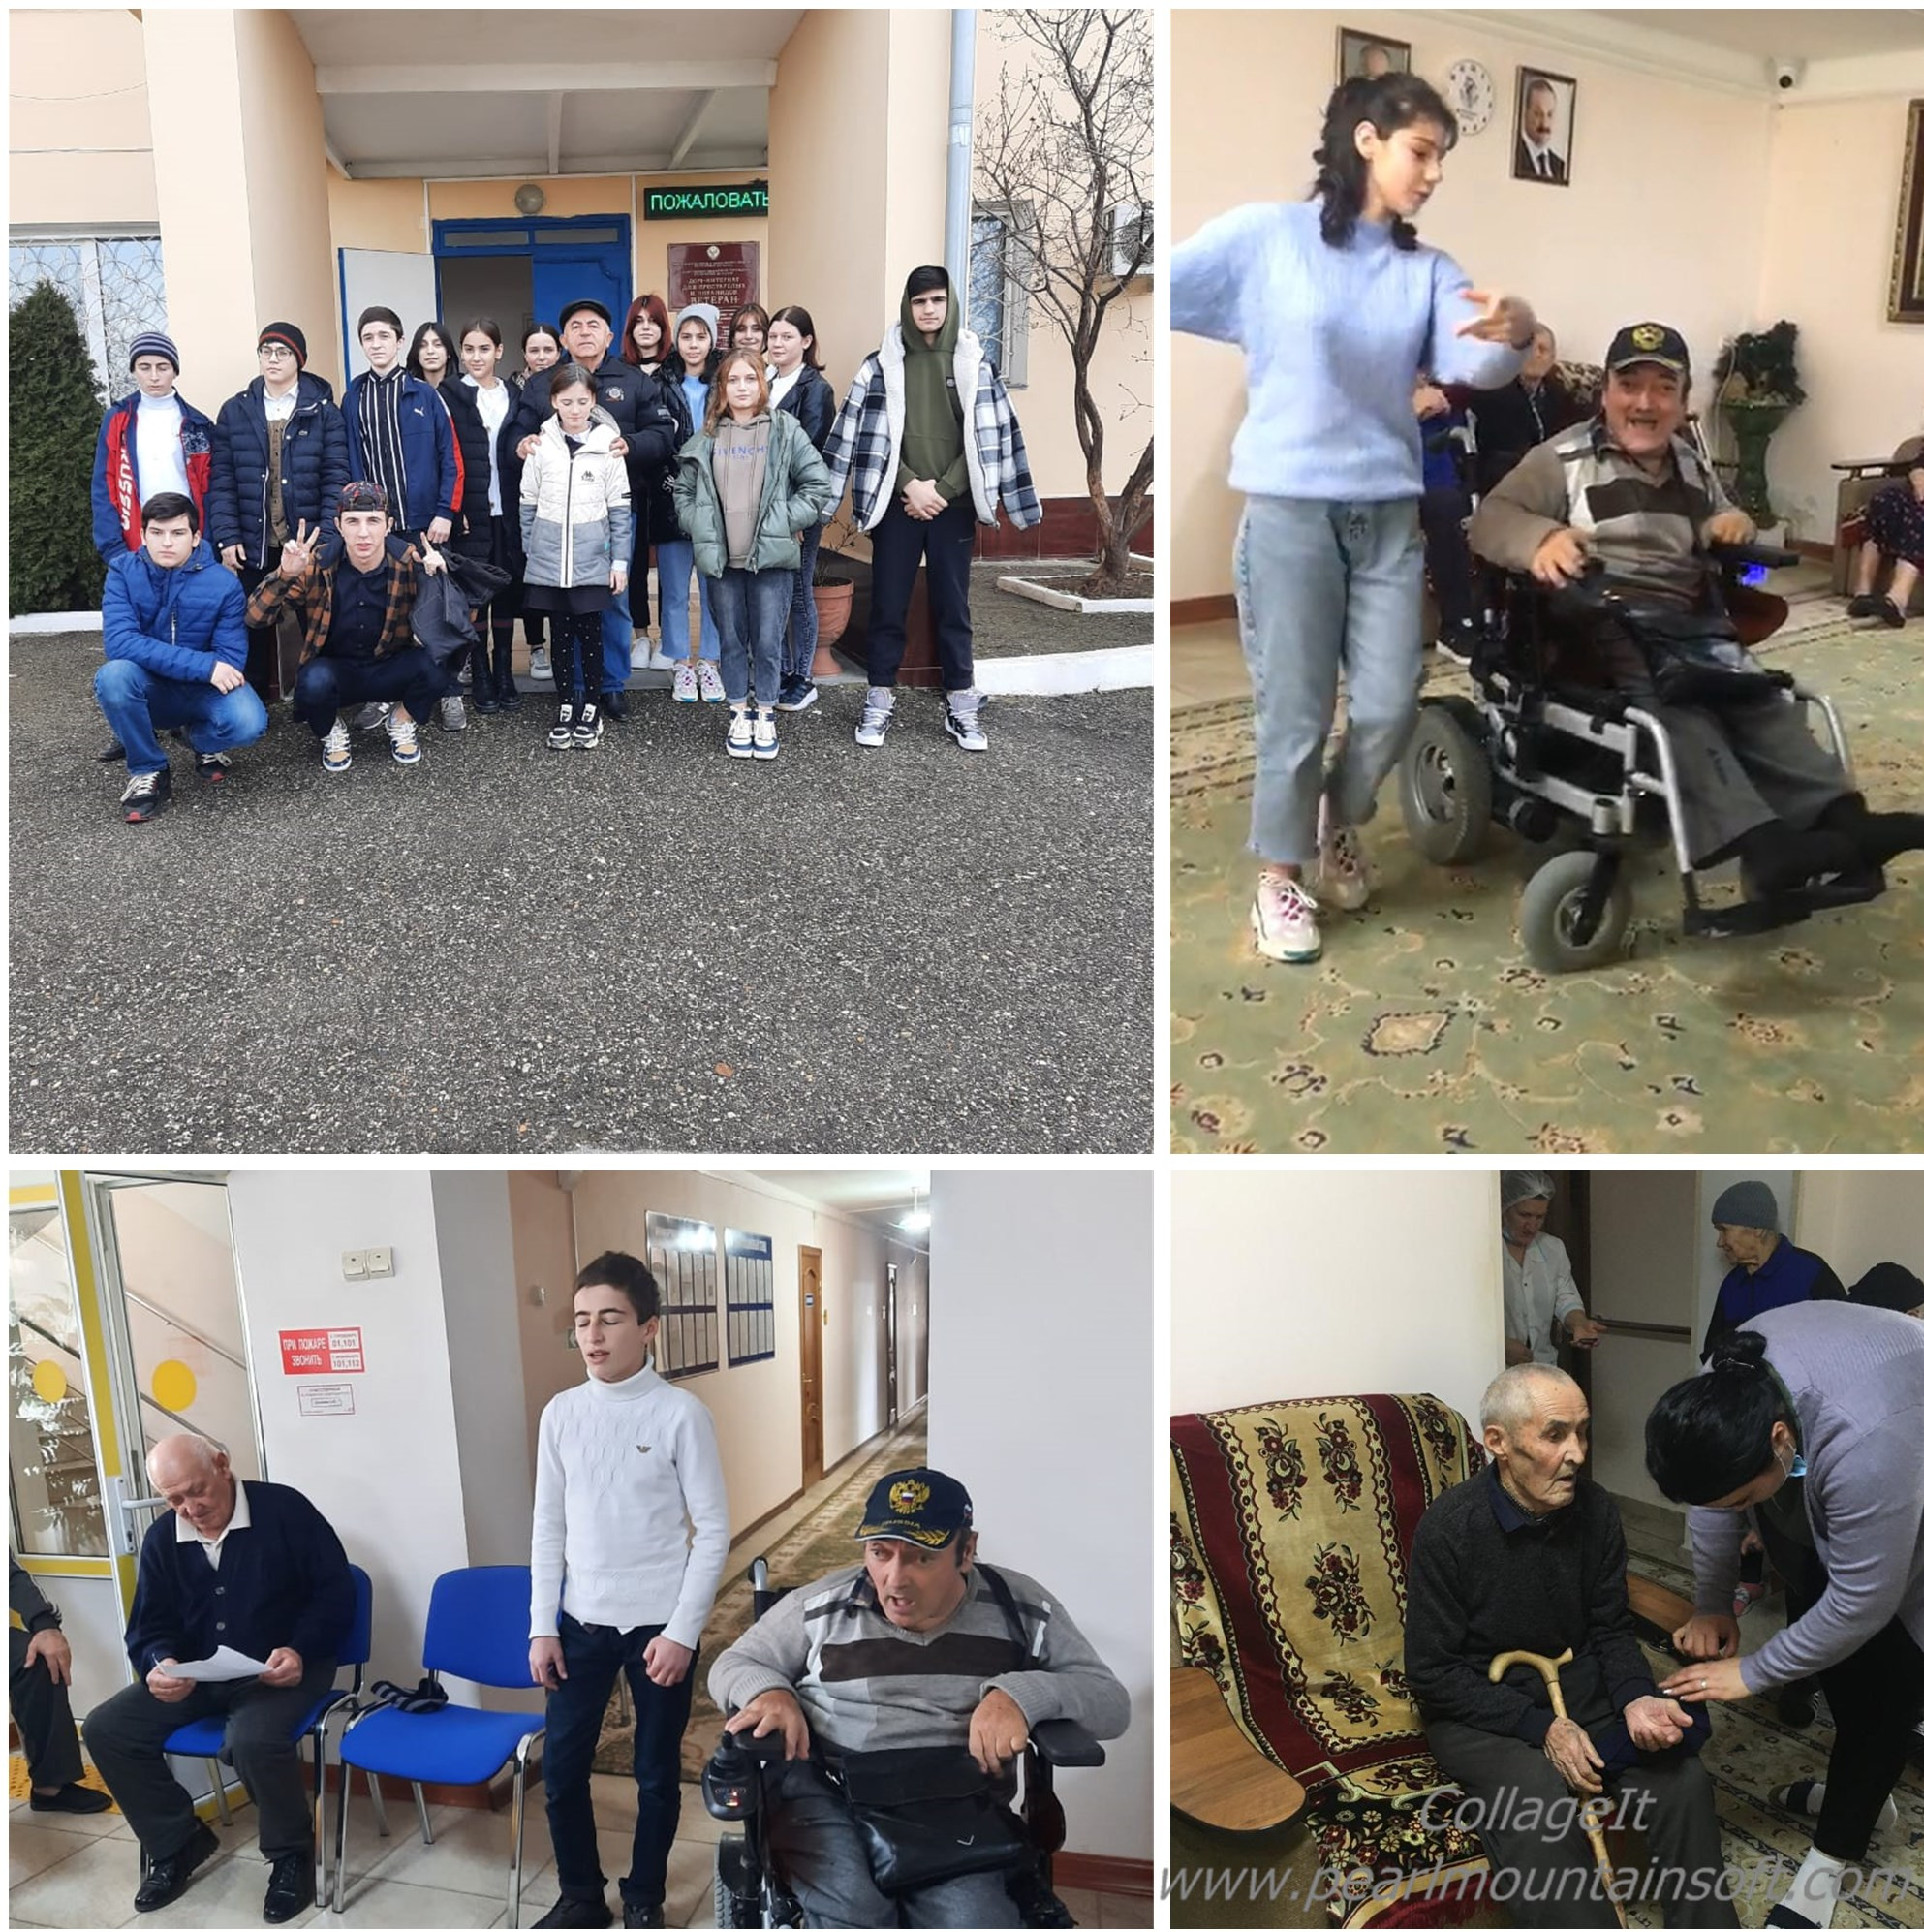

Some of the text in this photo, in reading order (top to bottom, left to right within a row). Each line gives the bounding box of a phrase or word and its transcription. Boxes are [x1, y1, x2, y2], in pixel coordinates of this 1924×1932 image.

[651, 191, 768, 211] ПОЖАЛОВАТЬ
[282, 1337, 327, 1351] ПРИ ПОЖАРЕ
[291, 1354, 323, 1367] ЗВОНИТЬ
